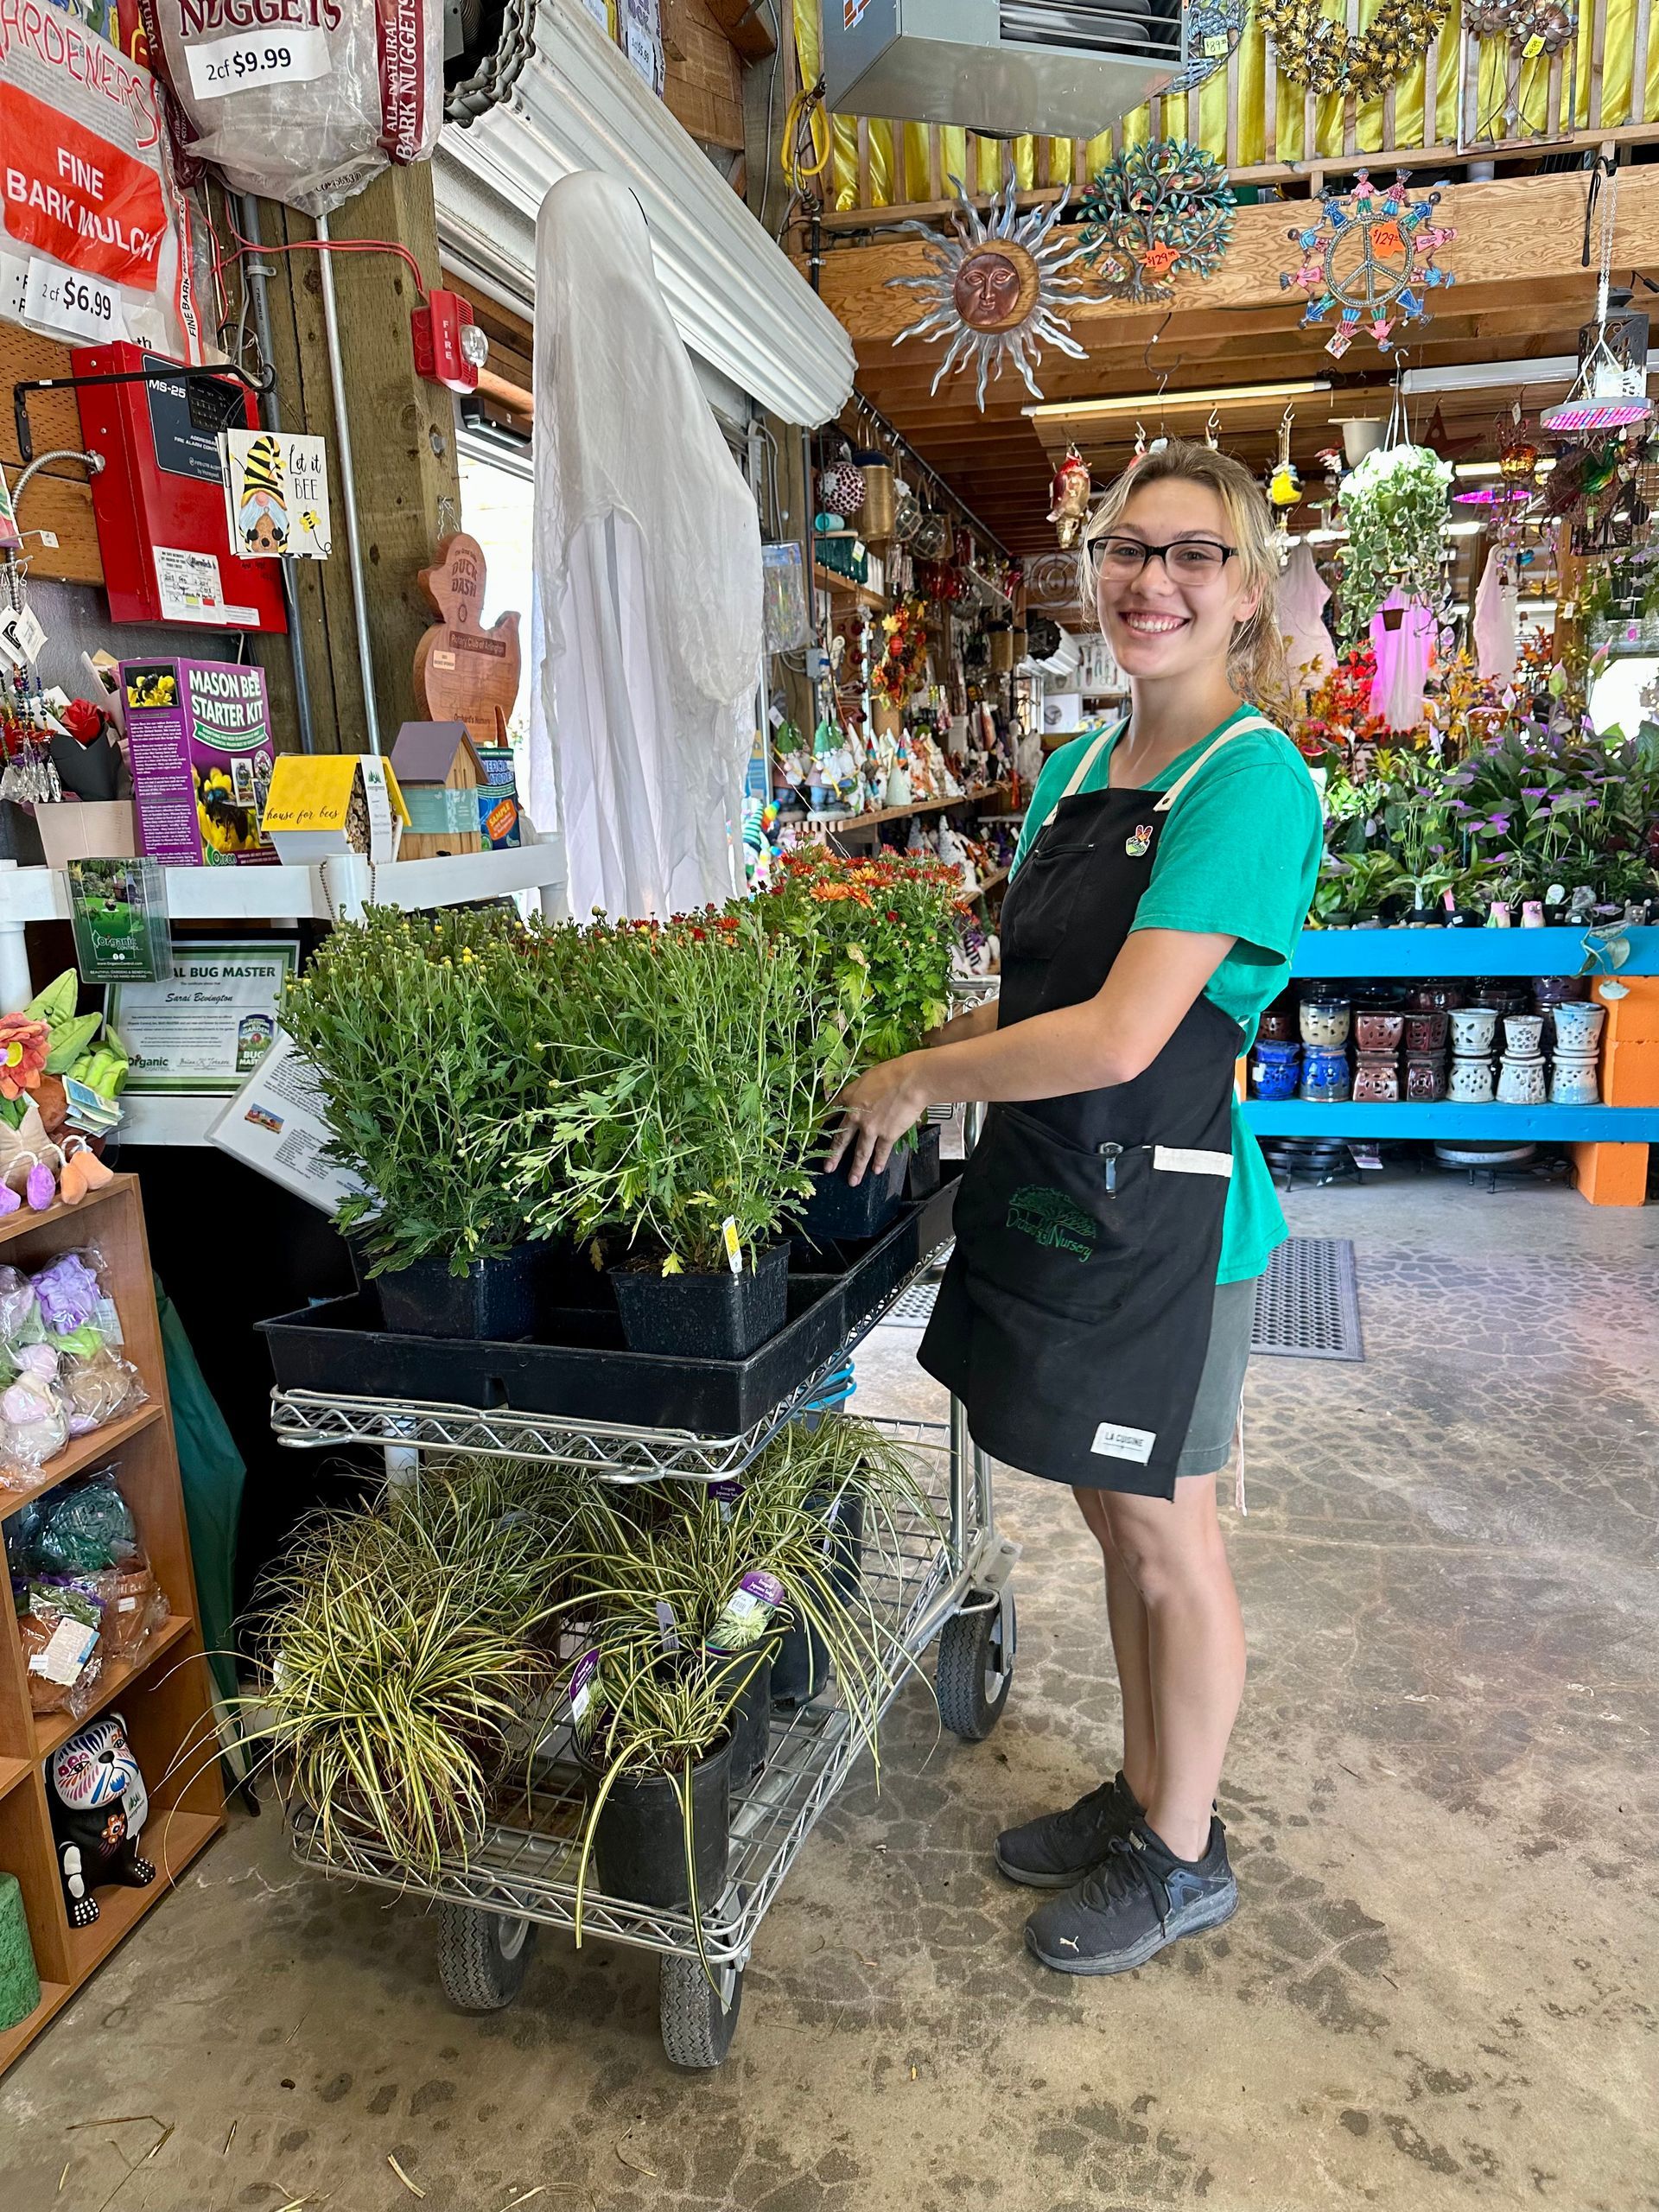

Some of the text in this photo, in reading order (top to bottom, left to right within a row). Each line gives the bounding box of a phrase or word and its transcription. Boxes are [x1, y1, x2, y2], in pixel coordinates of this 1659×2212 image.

[206, 48, 292, 81] 2cf $9.99
[386, 16, 399, 131] ALL NATURAL
[396, 0, 417, 160] BARK NUGGETS
[57, 146, 105, 201] FINE
[6, 167, 158, 263] BARK MULCH
[41, 276, 111, 321] 2 cf $6.99
[181, 278, 192, 310] BARK
[185, 311, 197, 338] FINE
[442, 320, 453, 360] FIRE
[149, 379, 186, 399] MS-25
[185, 440, 202, 449] ALARM
[289, 443, 321, 475] Let it
[295, 478, 319, 500] BEE
[452, 559, 477, 582] DUCK
[452, 577, 477, 598] DASH
[189, 670, 261, 698] MASON BEE
[191, 694, 263, 727] STARTER KIT
[267, 805, 339, 824] house for bees
[488, 802, 511, 827] SAMPLE
[97, 935, 137, 948] Organic
[190, 967, 219, 977] BUG
[222, 967, 276, 977] MASTER
[128, 1055, 168, 1068] Organic
[1048, 1223, 1093, 1262] Nursery
